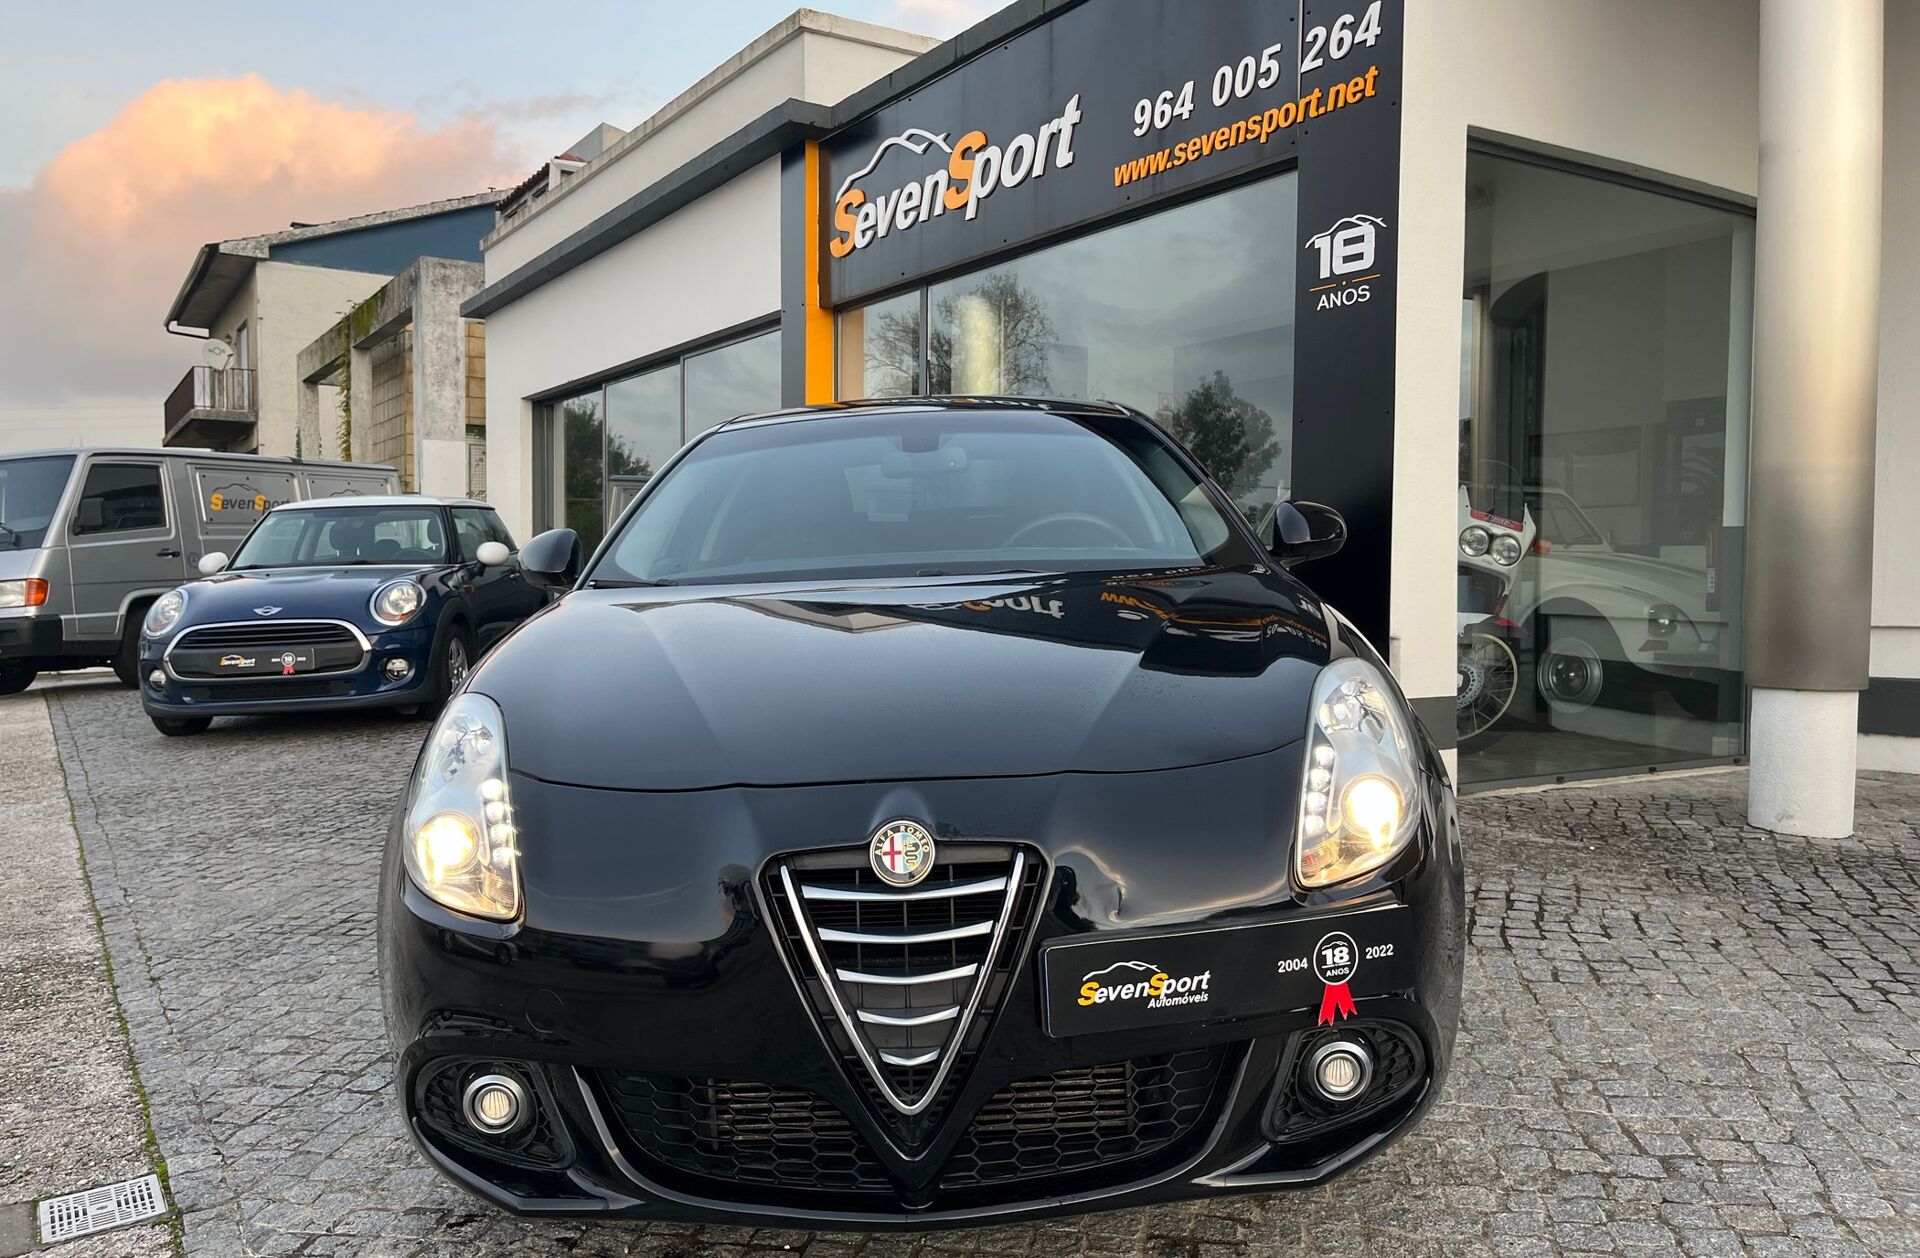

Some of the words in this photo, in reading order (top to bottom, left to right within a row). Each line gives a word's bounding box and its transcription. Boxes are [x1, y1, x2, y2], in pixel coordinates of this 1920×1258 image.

[1133, 81, 1195, 137] 964
[1212, 43, 1282, 107] 005
[1300, 0, 1382, 74] 264
[1114, 65, 1379, 187] www.sevensport.net
[829, 94, 1082, 258] SevenSport
[1314, 224, 1376, 279] 18
[1316, 285, 1371, 311] ANOS
[874, 829, 895, 856] ALFA
[899, 825, 930, 853] ROMEO
[1277, 957, 1309, 973] 2004
[1321, 946, 1351, 966] 18
[1365, 943, 1394, 960] 2022
[1325, 967, 1350, 978] ANOS
[1077, 969, 1211, 1006] SevenSport
[1147, 990, 1209, 1009] Automóveis
